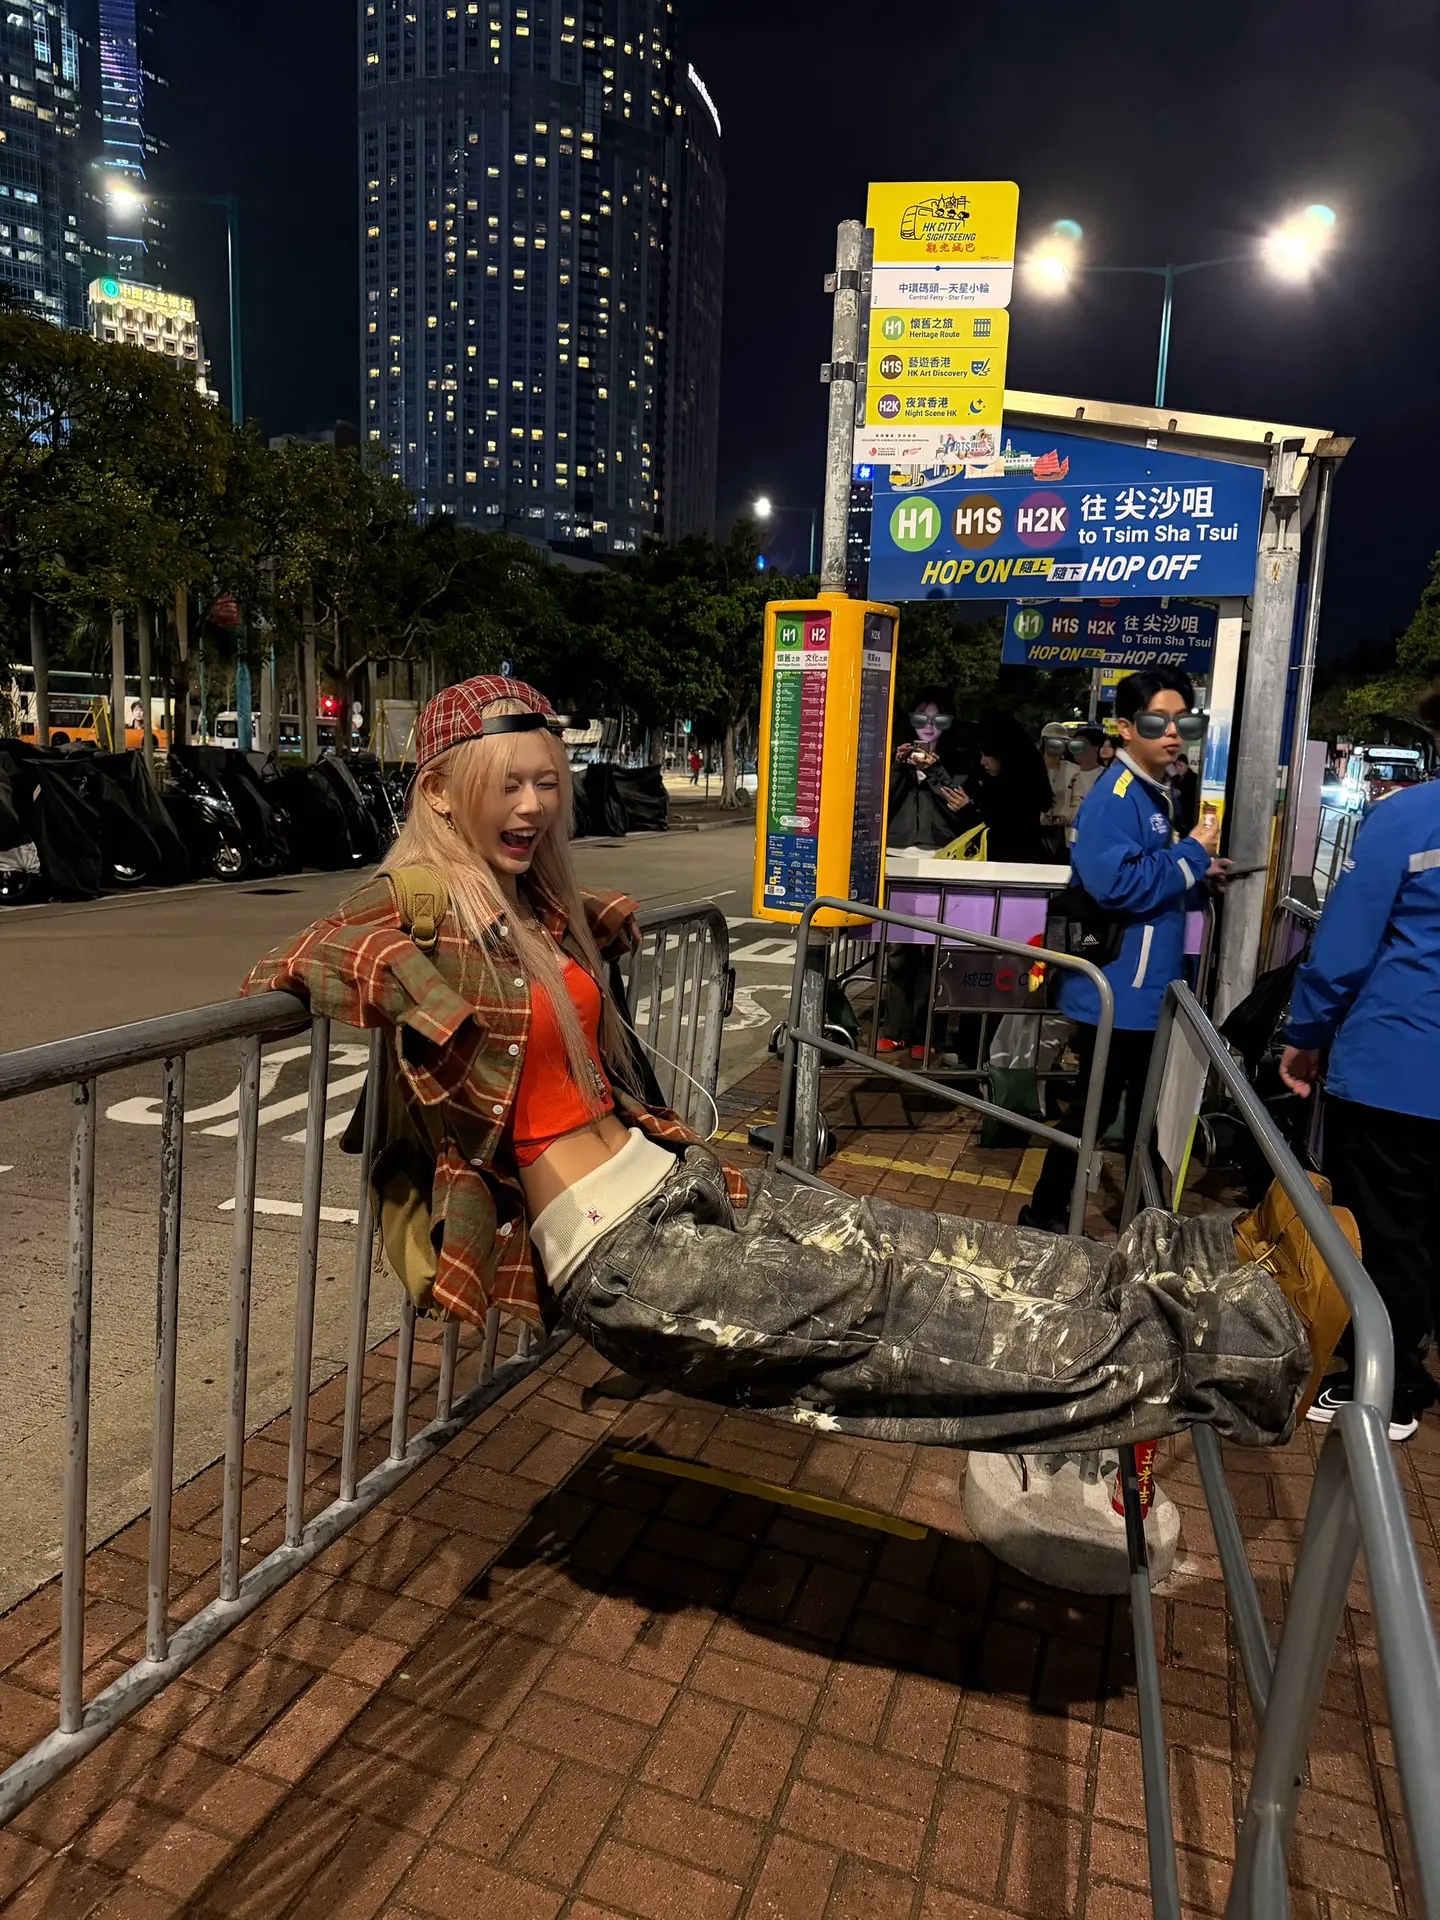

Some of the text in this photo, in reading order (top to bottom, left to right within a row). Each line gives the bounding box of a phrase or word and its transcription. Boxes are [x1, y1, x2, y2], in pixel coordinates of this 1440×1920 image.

[922, 222, 962, 232] HK CITY
[925, 233, 977, 241] SIGHTSEEING
[925, 242, 976, 253] 觀光城巴
[885, 320, 902, 336] H1
[910, 317, 954, 329] 懷舊之旅
[909, 331, 939, 339] Heritage
[881, 360, 902, 373] H1S
[932, 370, 968, 378] Discovery
[879, 400, 899, 412] H2K
[905, 397, 949, 408] 夜賞香港
[905, 410, 923, 418] Night
[897, 507, 1067, 540] H1 H1S H2K
[1078, 523, 1238, 544] to Tsim Sha Tsui
[921, 560, 972, 585] HOP
[975, 558, 1015, 583] ON
[1087, 556, 1146, 582] HOP
[1147, 554, 1202, 580] OFF
[1017, 614, 1117, 635] H1 H1S H2K
[782, 628, 796, 642] H1
[811, 628, 826, 642] H2
[1121, 634, 1212, 648] to Tsim Sha Tsui
[1028, 645, 1060, 660] HOP
[1060, 646, 1082, 661] ON
[1123, 650, 1157, 665] HOP
[1157, 652, 1188, 667] OFF
[1104, 670, 1113, 678] 15
